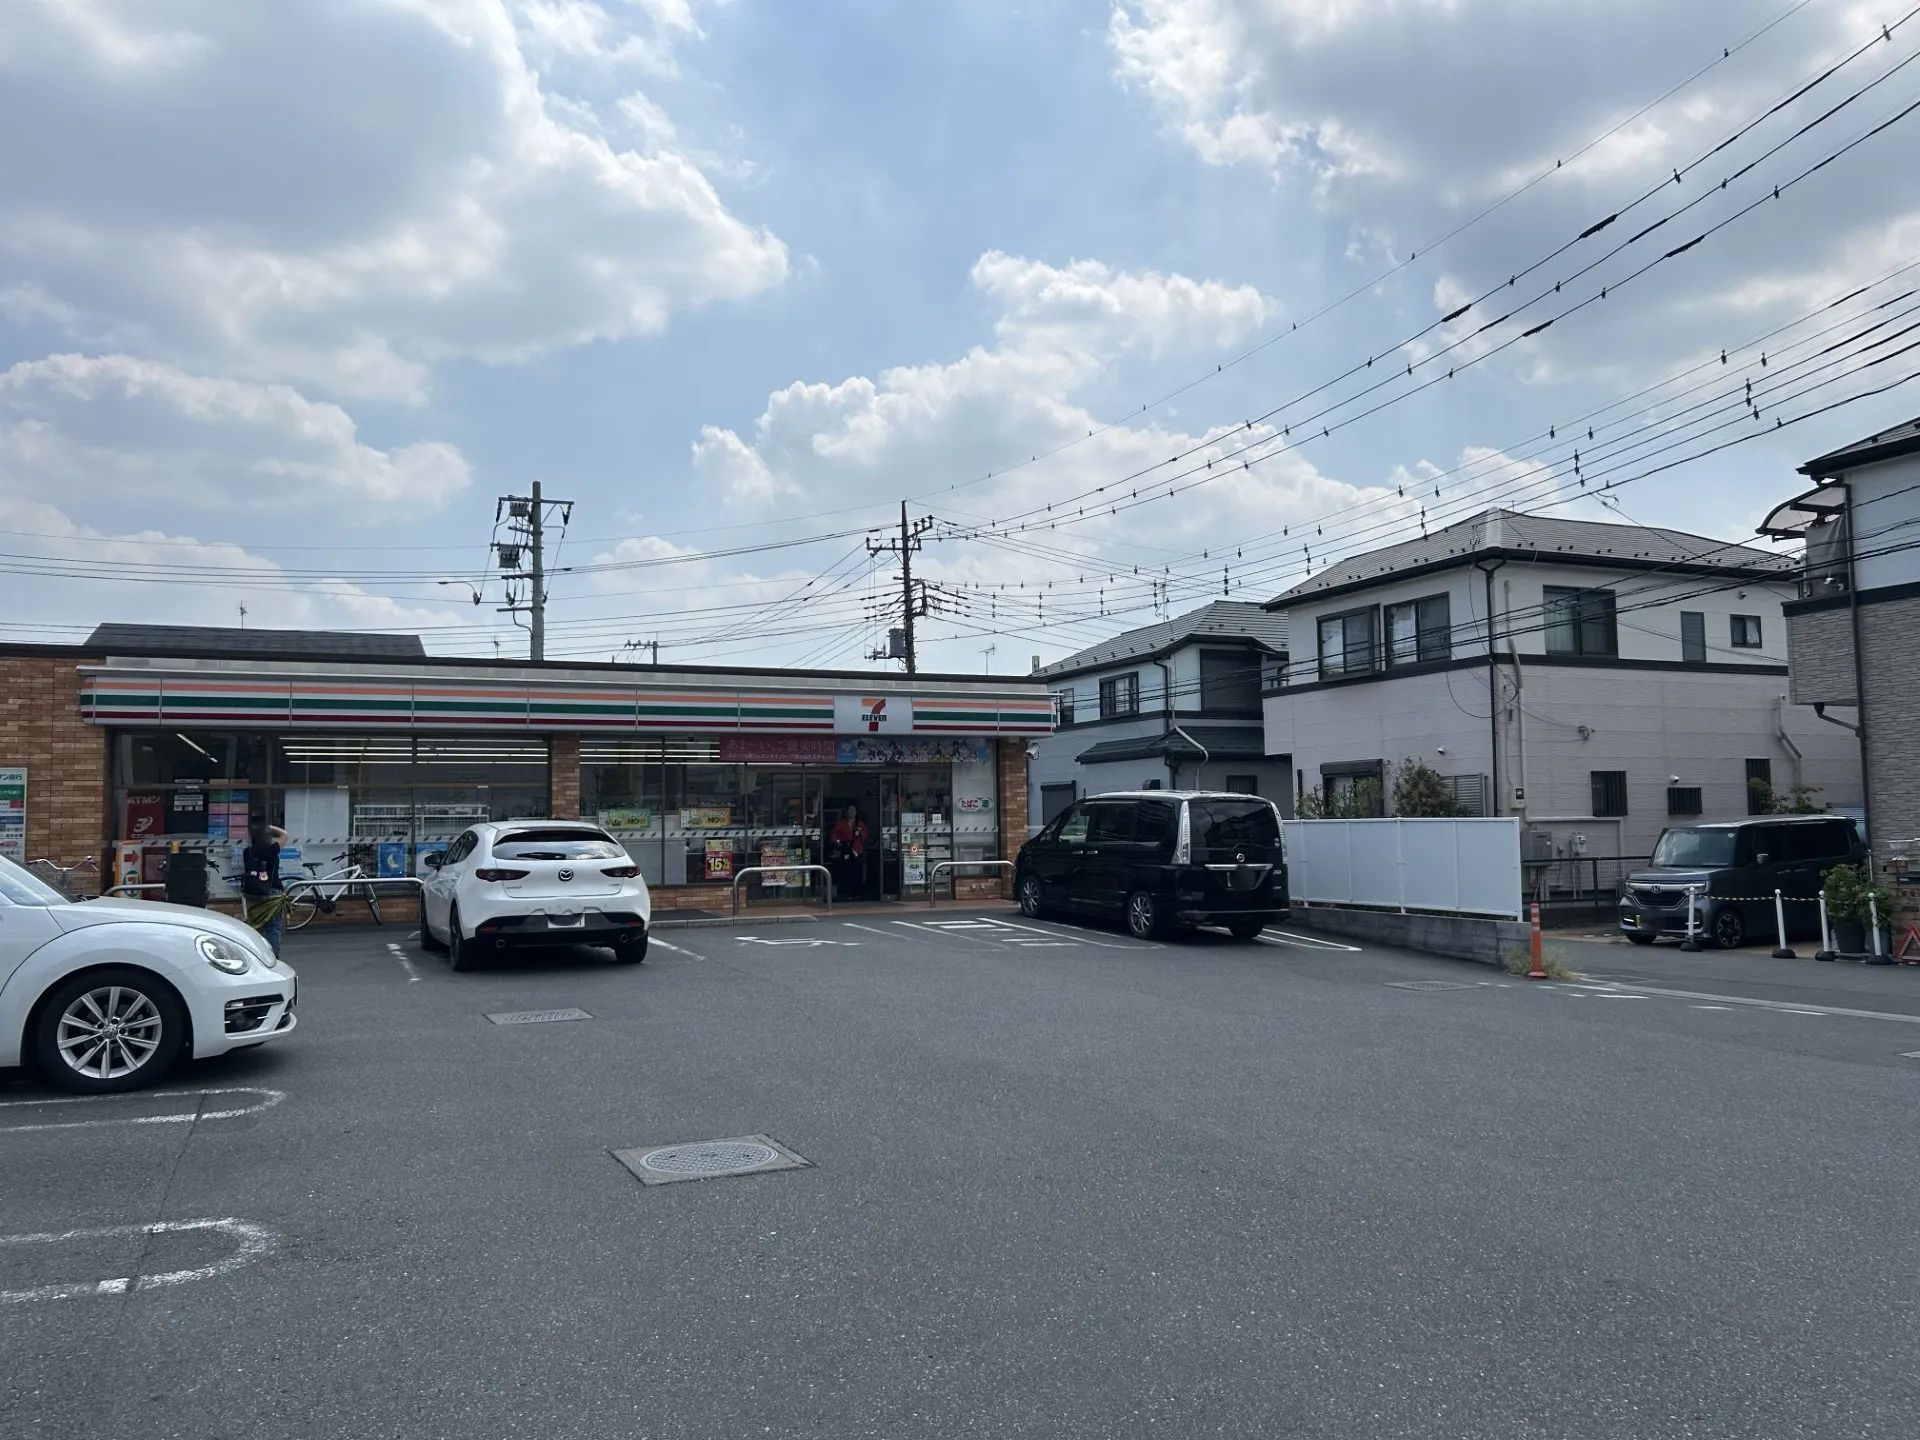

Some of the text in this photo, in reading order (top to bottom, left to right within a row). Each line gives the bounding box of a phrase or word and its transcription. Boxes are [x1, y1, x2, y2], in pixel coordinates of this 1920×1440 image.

[862, 698, 886, 732] 7
[127, 796, 152, 805] ATM
[961, 800, 979, 808] たばこ
